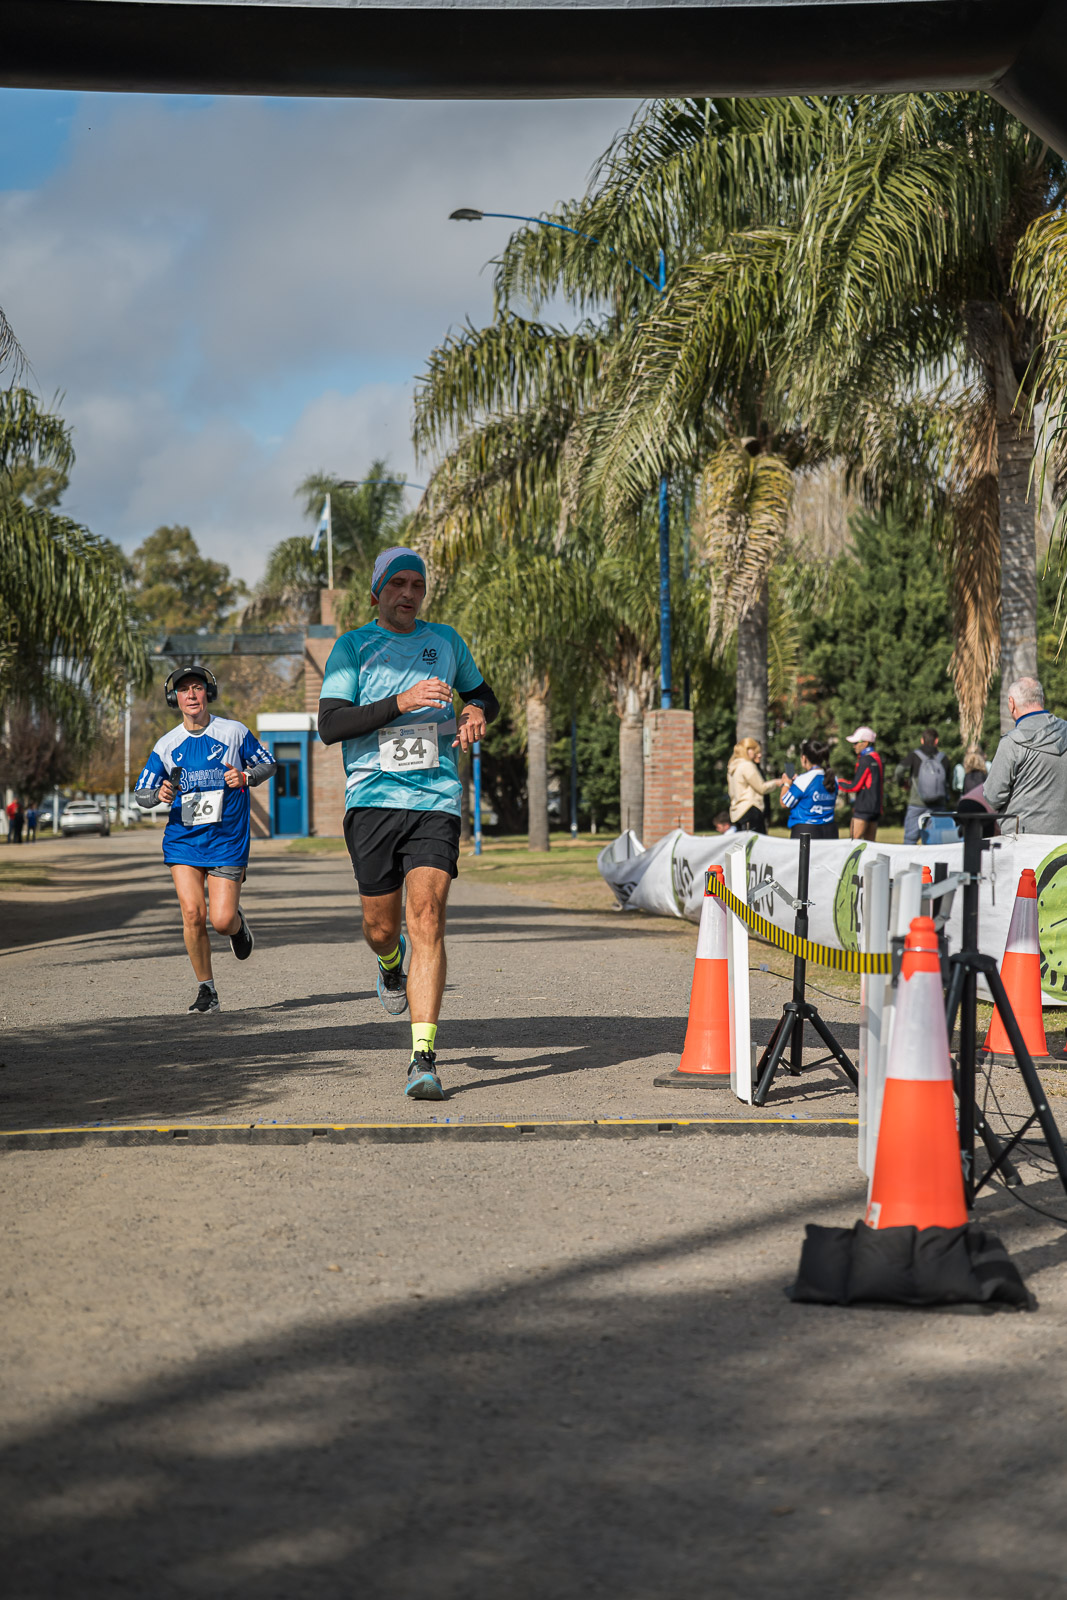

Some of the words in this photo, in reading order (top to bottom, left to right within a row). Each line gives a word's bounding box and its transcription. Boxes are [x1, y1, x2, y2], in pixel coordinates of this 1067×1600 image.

[422, 648, 437, 658] AG
[393, 737, 427, 761] 34
[191, 801, 213, 817] 26
